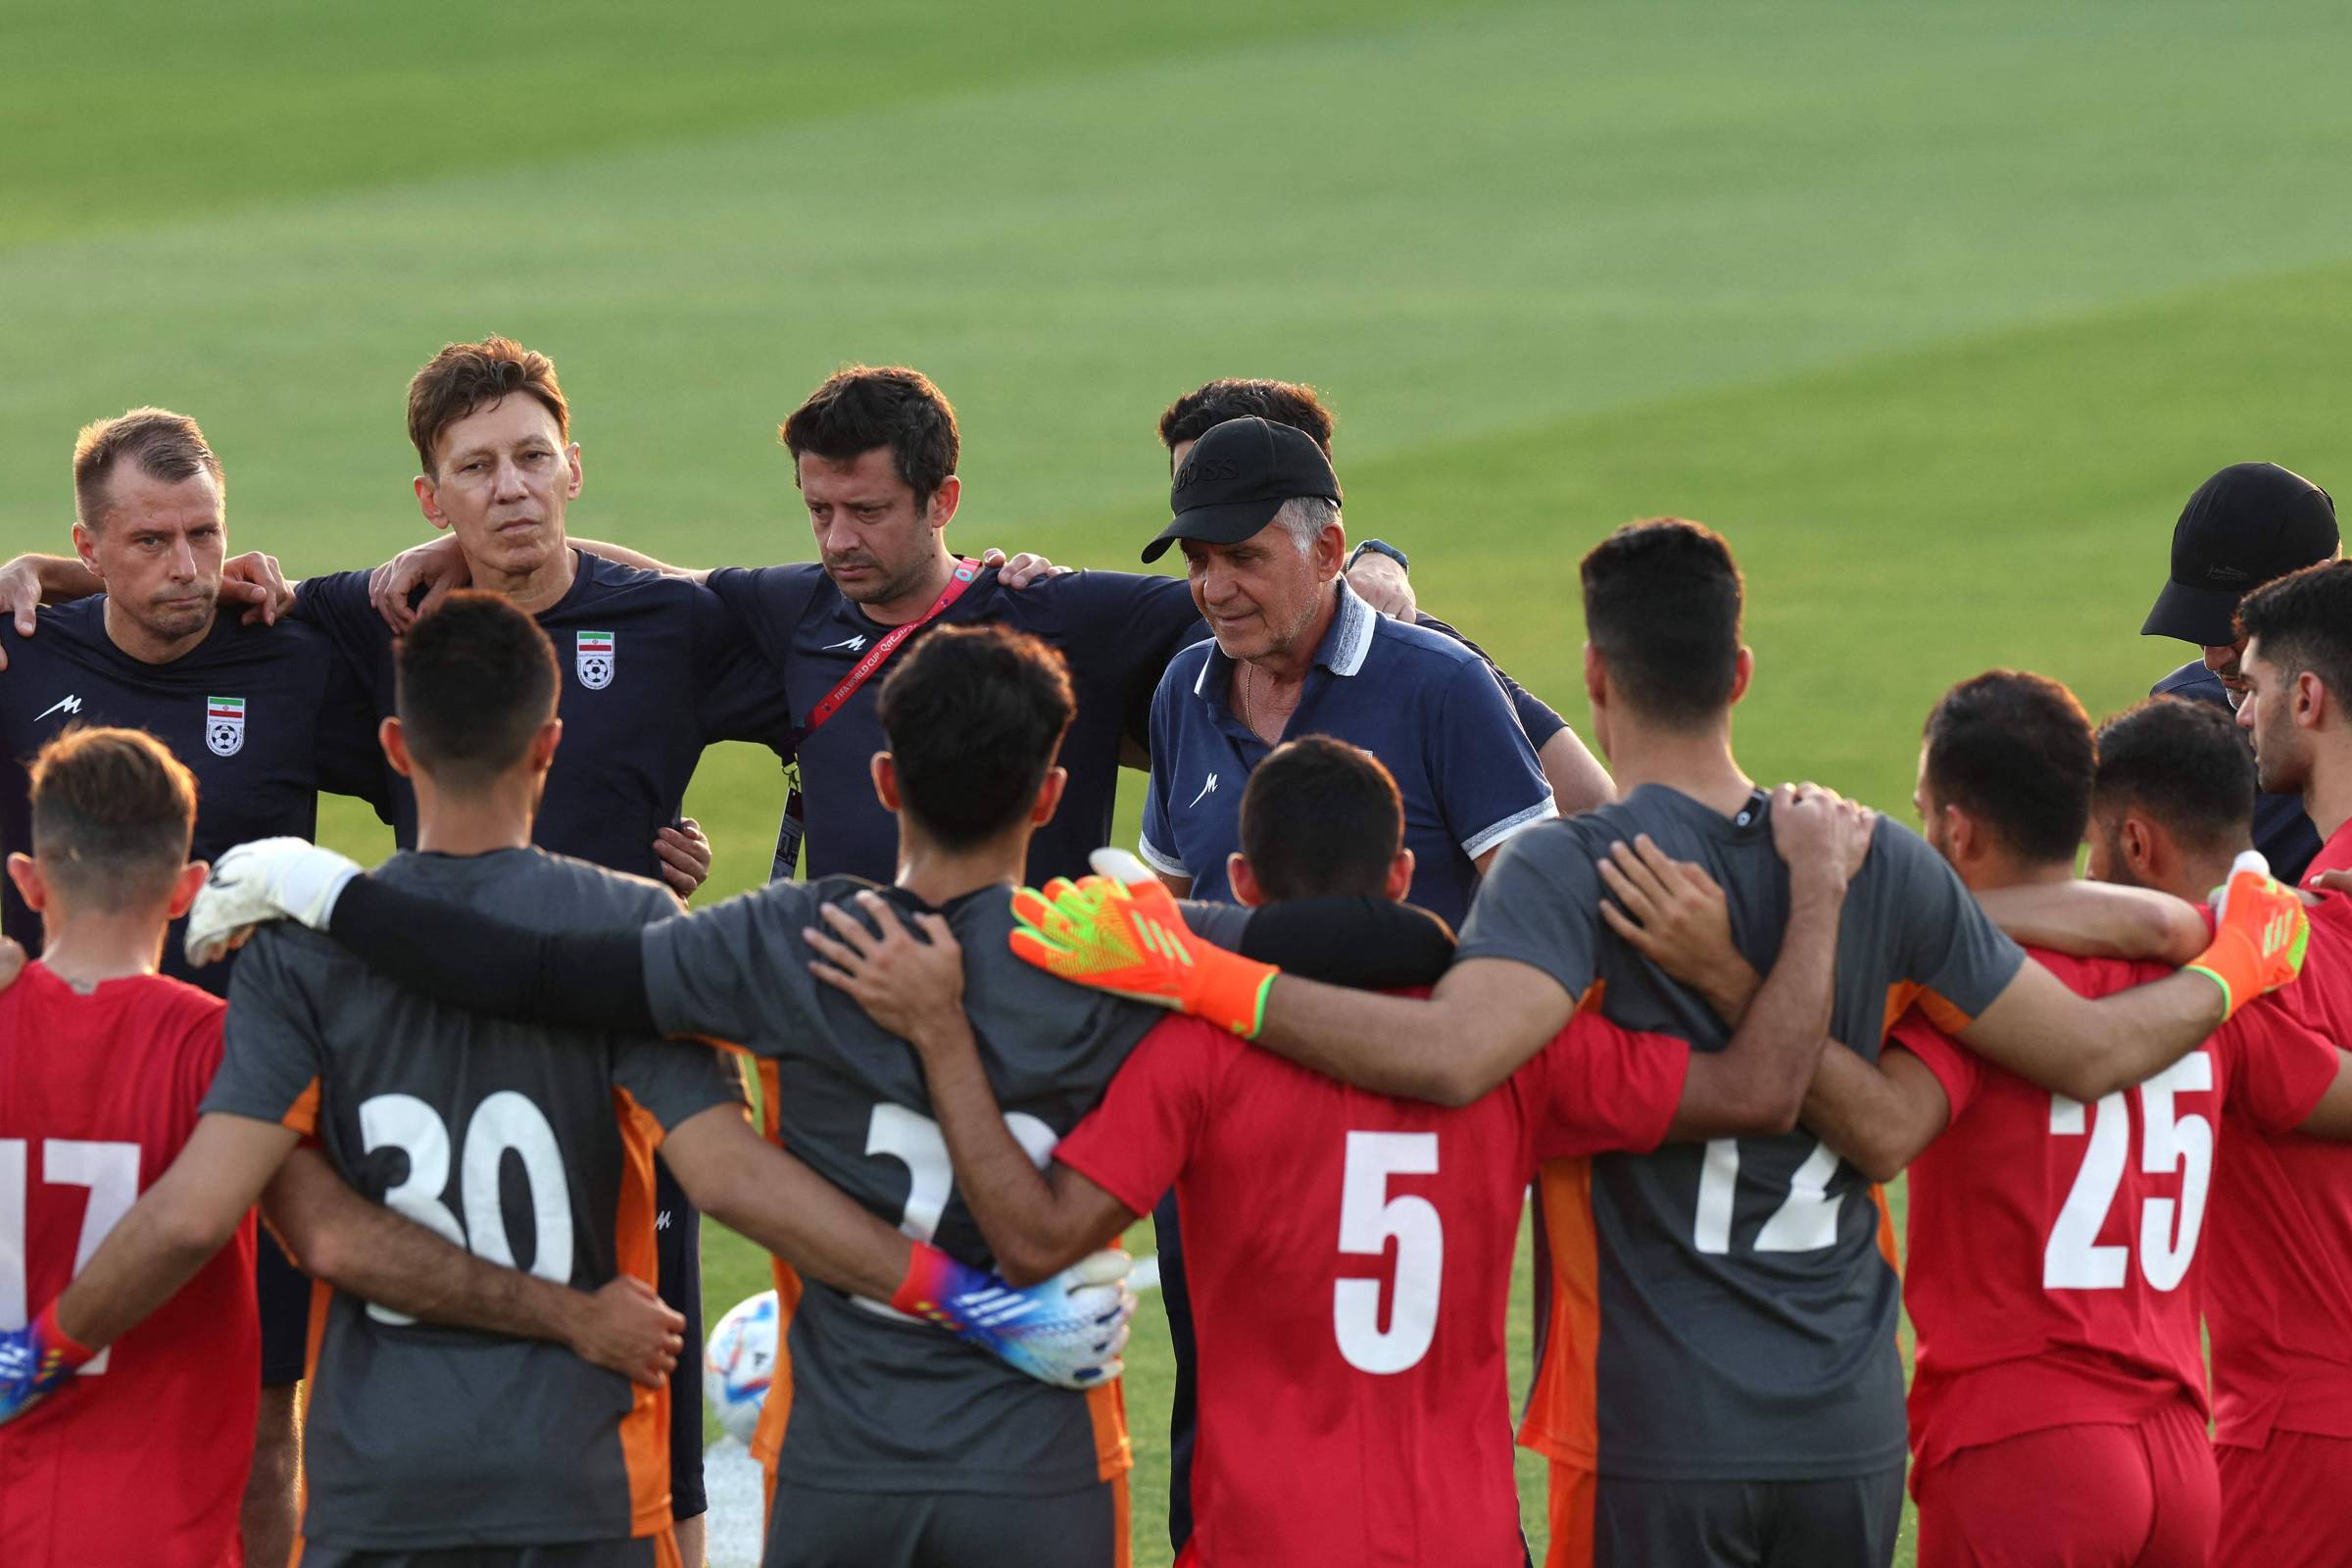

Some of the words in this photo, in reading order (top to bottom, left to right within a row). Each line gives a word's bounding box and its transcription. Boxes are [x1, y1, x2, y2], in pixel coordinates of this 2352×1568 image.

[834, 683, 851, 701] FIFA
[848, 666, 870, 688] WORLD
[867, 653, 879, 667] CUP
[359, 1090, 574, 1325] 30
[1334, 1131, 1444, 1374] 5
[2042, 1051, 2213, 1291] 25
